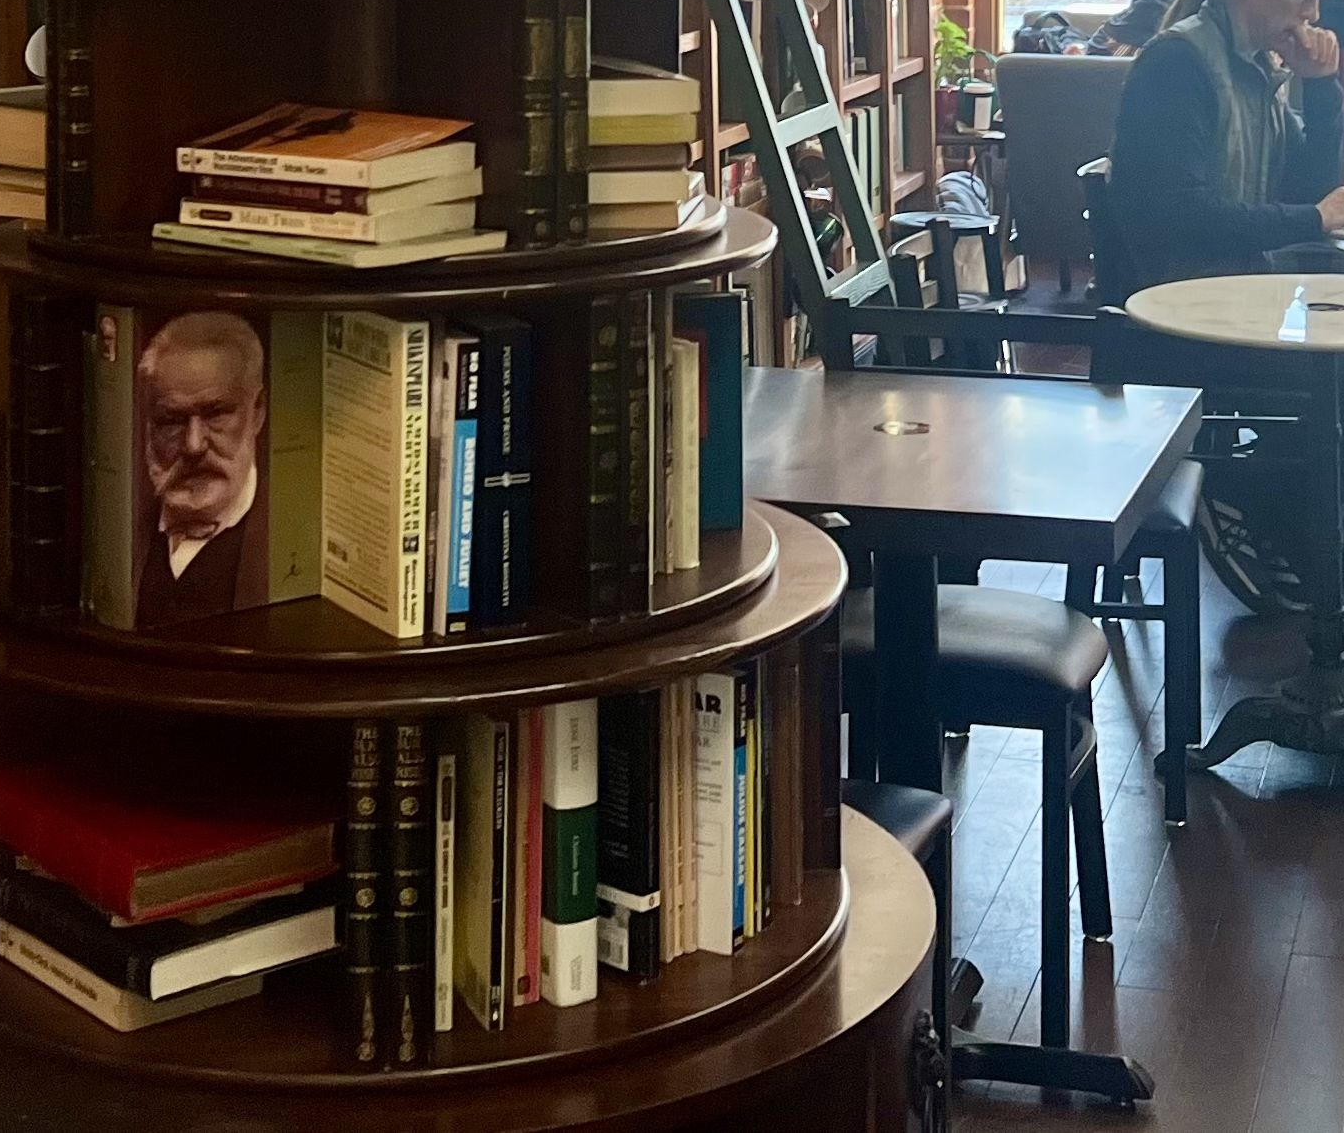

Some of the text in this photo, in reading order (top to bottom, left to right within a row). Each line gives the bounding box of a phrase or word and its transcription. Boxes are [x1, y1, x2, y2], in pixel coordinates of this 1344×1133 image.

[468, 351, 480, 411] NO FEAR
[459, 437, 476, 588] ROMEO AND JULIET
